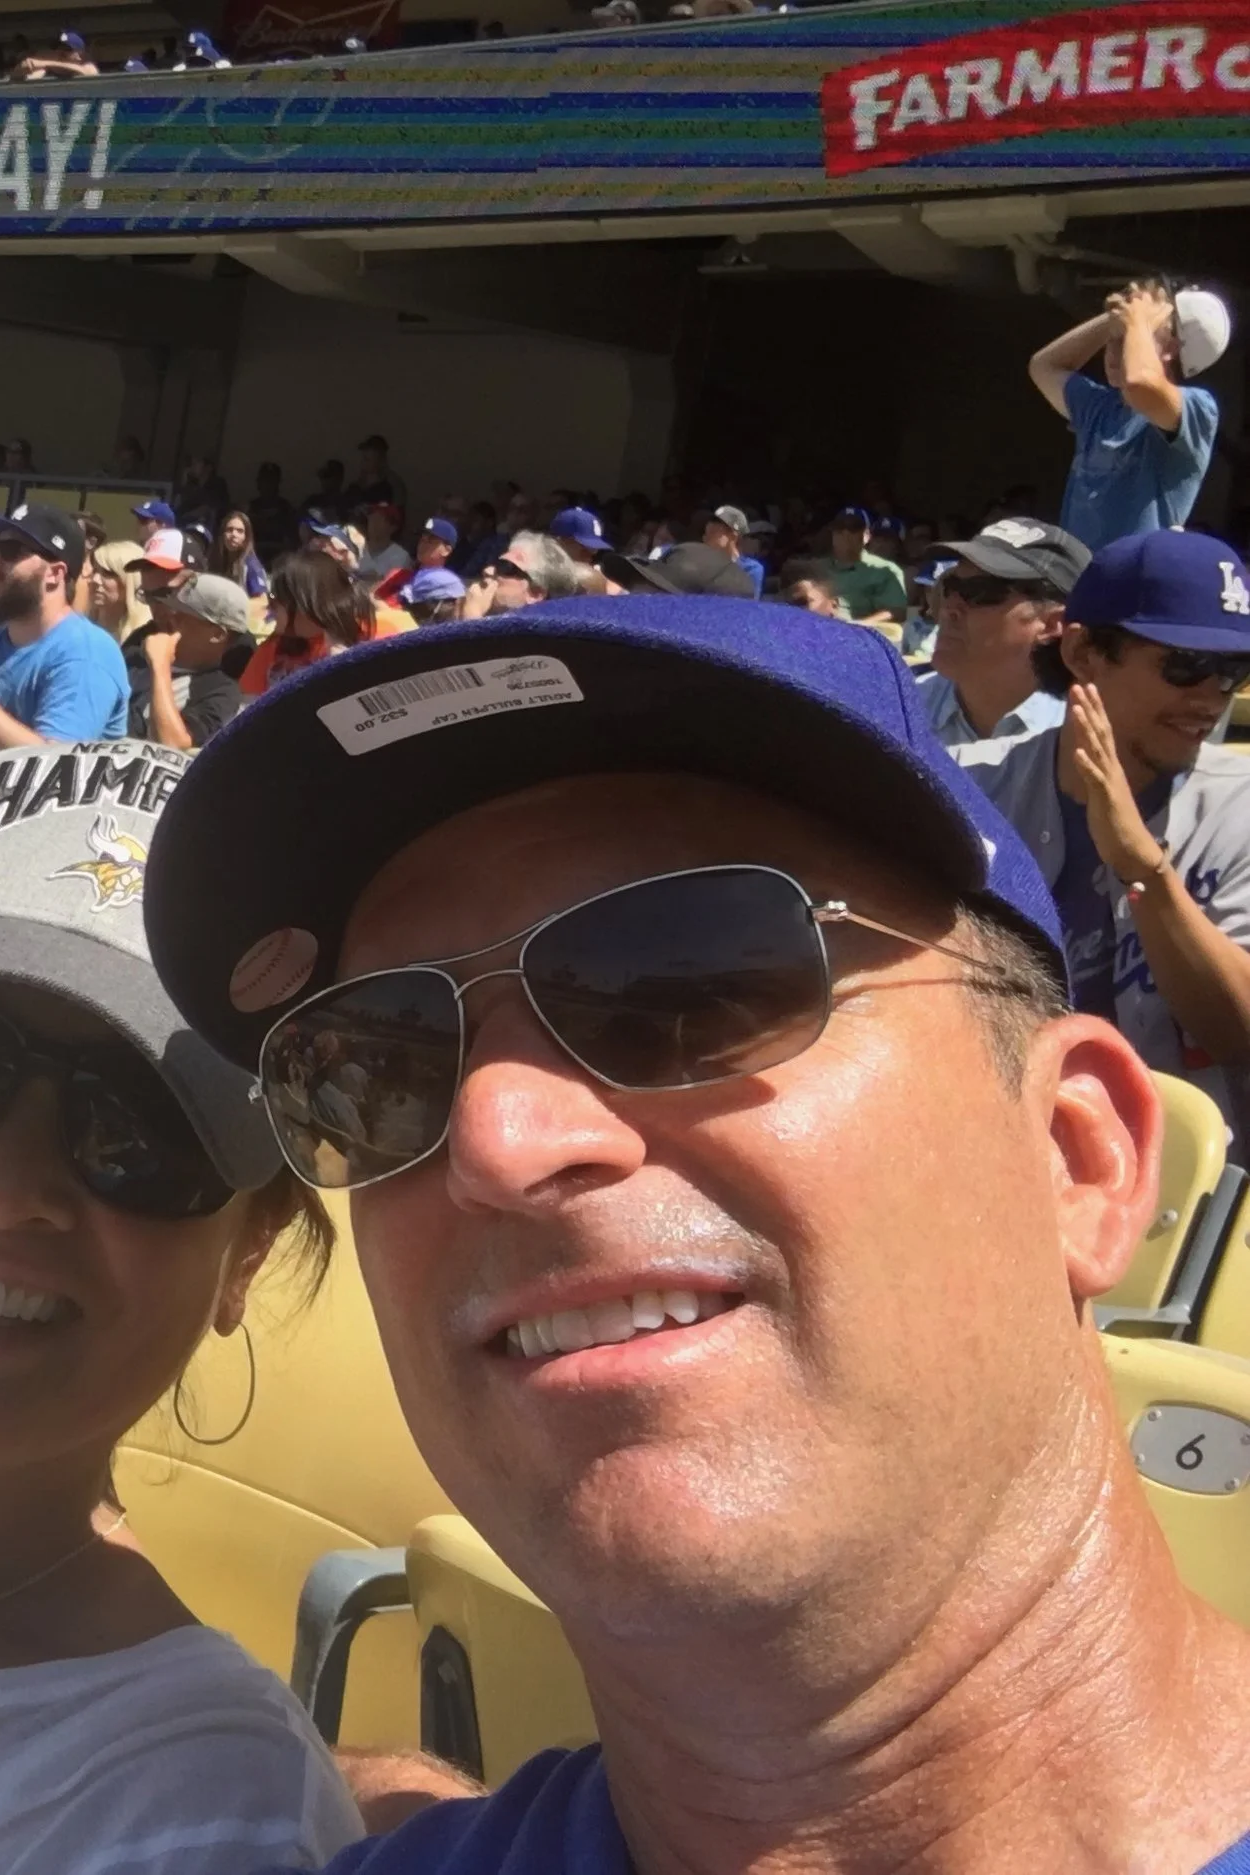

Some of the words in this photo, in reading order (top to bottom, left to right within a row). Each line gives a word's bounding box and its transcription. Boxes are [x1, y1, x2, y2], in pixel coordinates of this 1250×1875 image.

[849, 26, 1207, 151] FARMER
[461, 697, 523, 718] BULLPEN
[525, 692, 573, 707] ADULT
[353, 707, 409, 733] $32.00
[431, 710, 460, 726] CAP
[71, 742, 131, 755] NFC
[1175, 1433, 1206, 1471] 6
